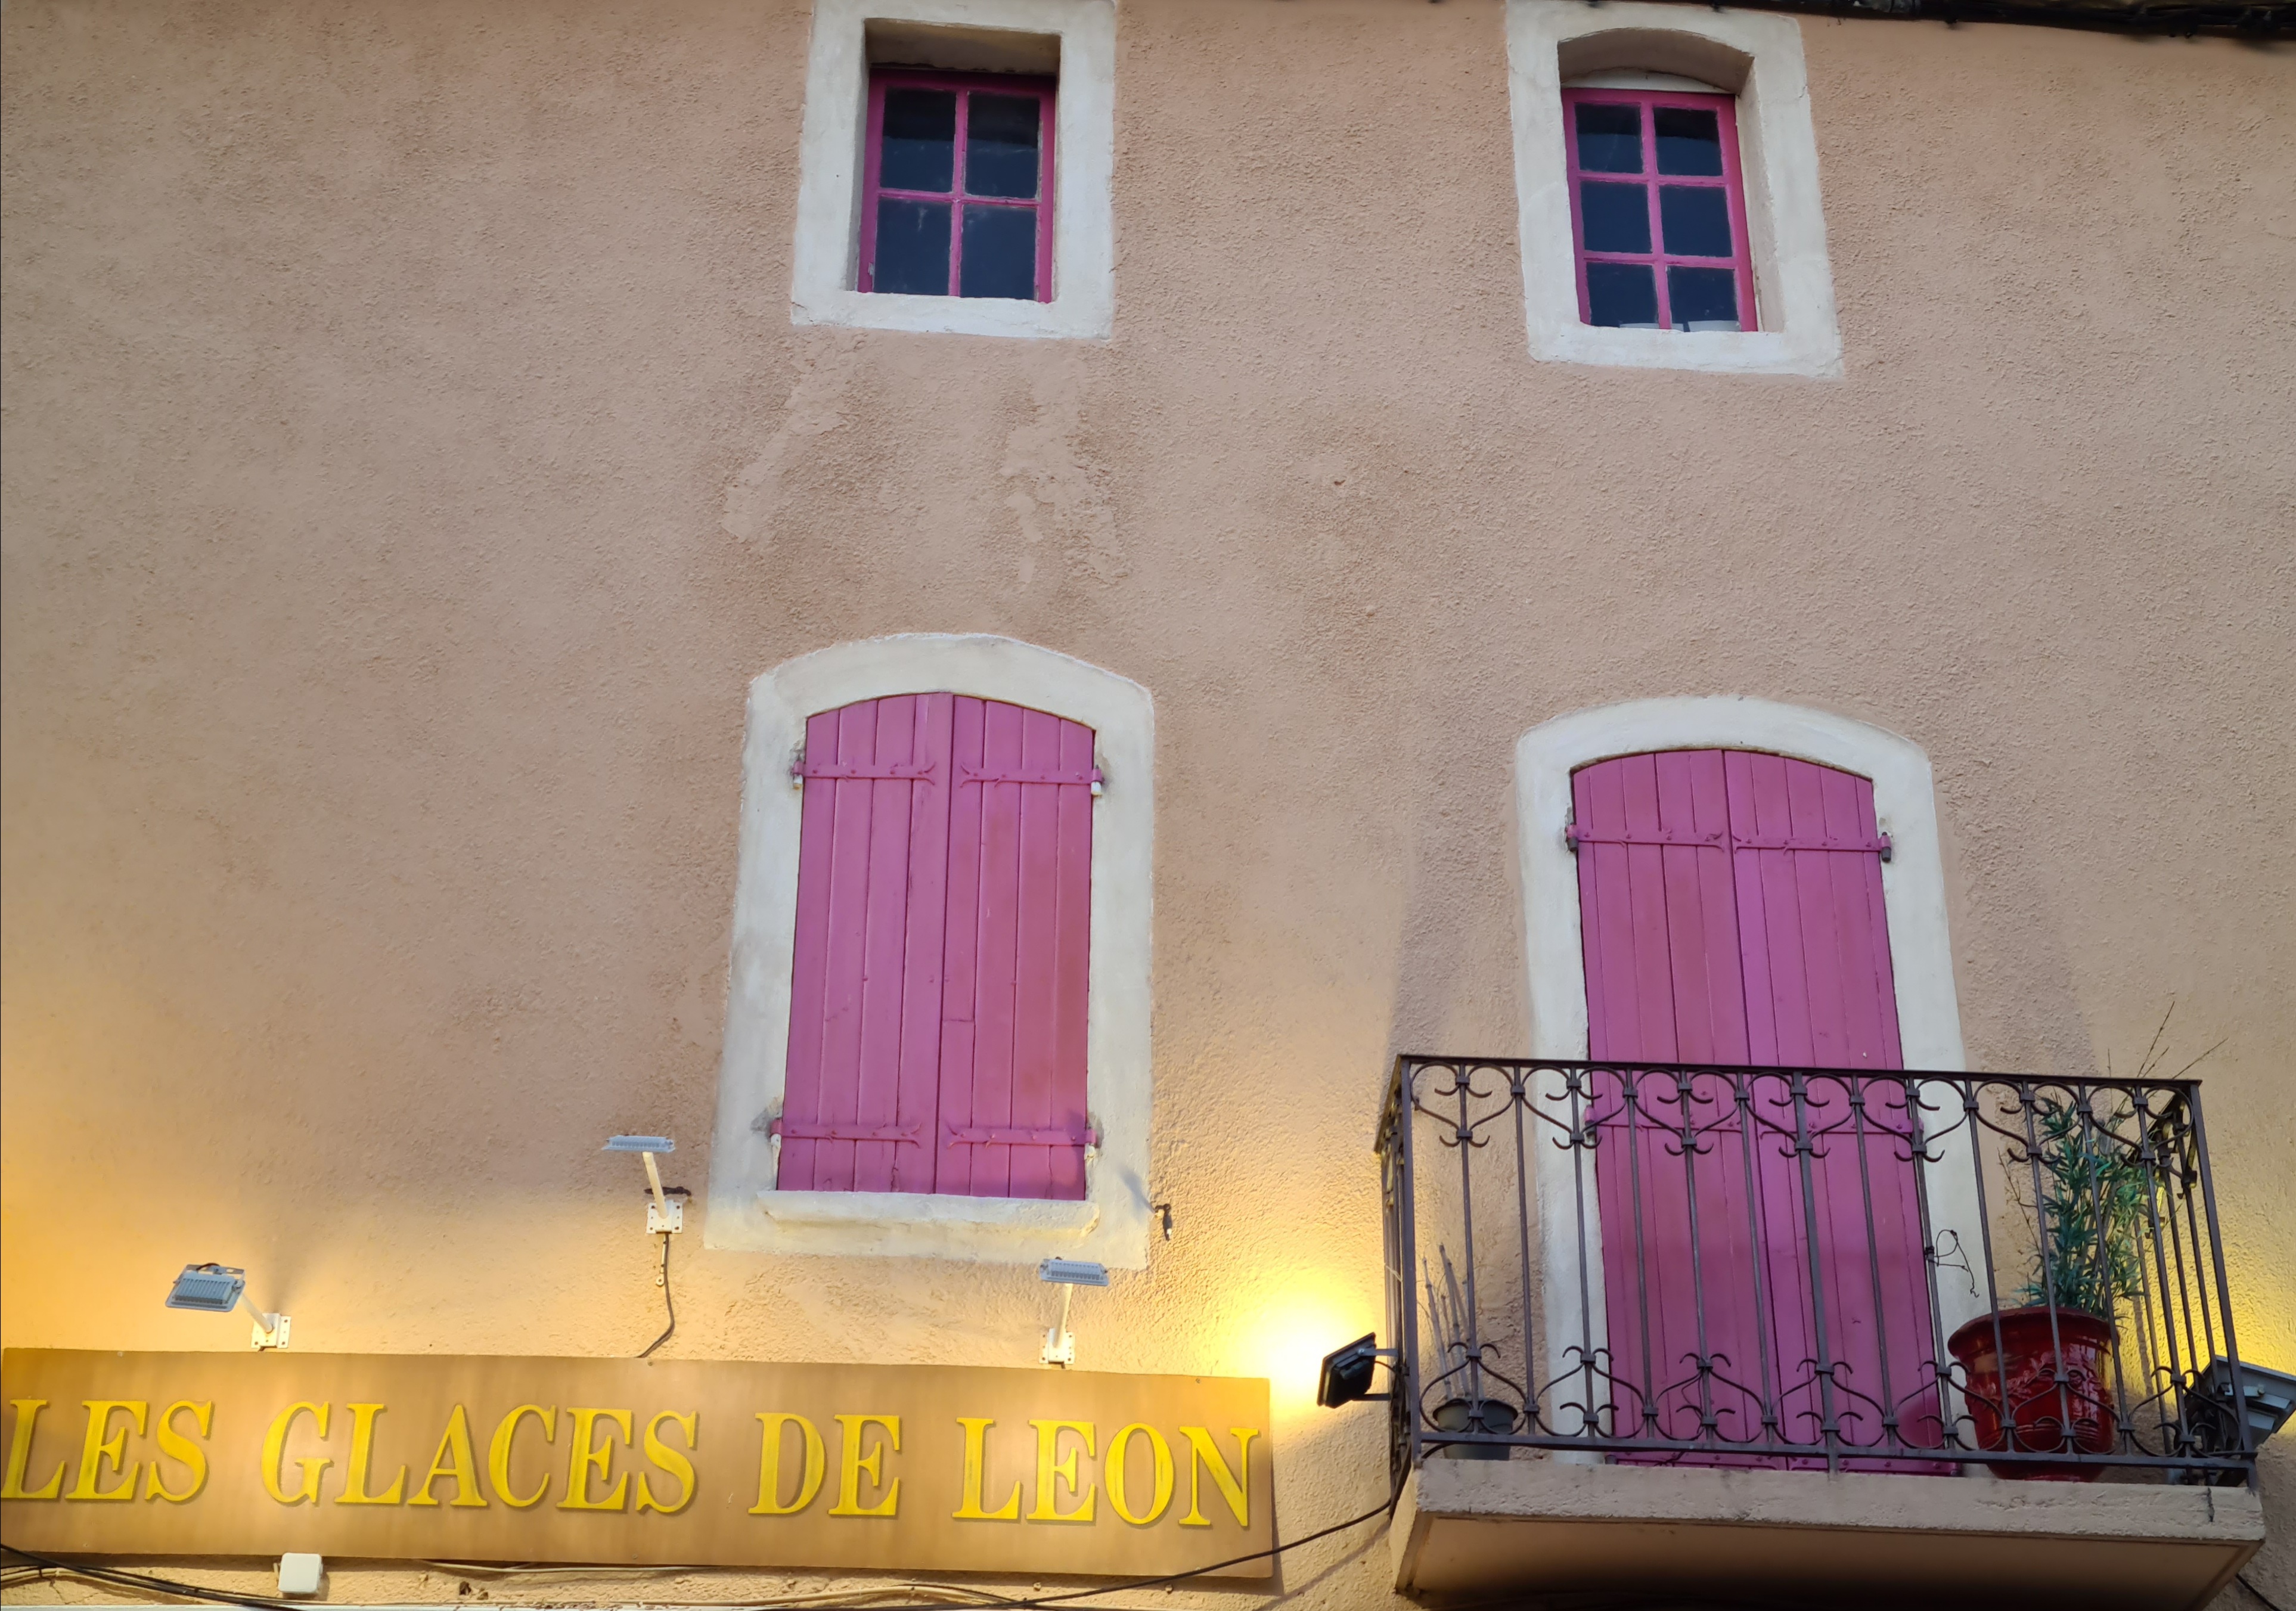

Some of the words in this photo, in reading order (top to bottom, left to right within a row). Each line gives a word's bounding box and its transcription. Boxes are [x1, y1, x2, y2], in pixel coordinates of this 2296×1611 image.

[1, 1399, 213, 1501] LES
[261, 1401, 697, 1513] GLACES
[747, 1413, 900, 1516] DE
[952, 1417, 1259, 1527] LEON
